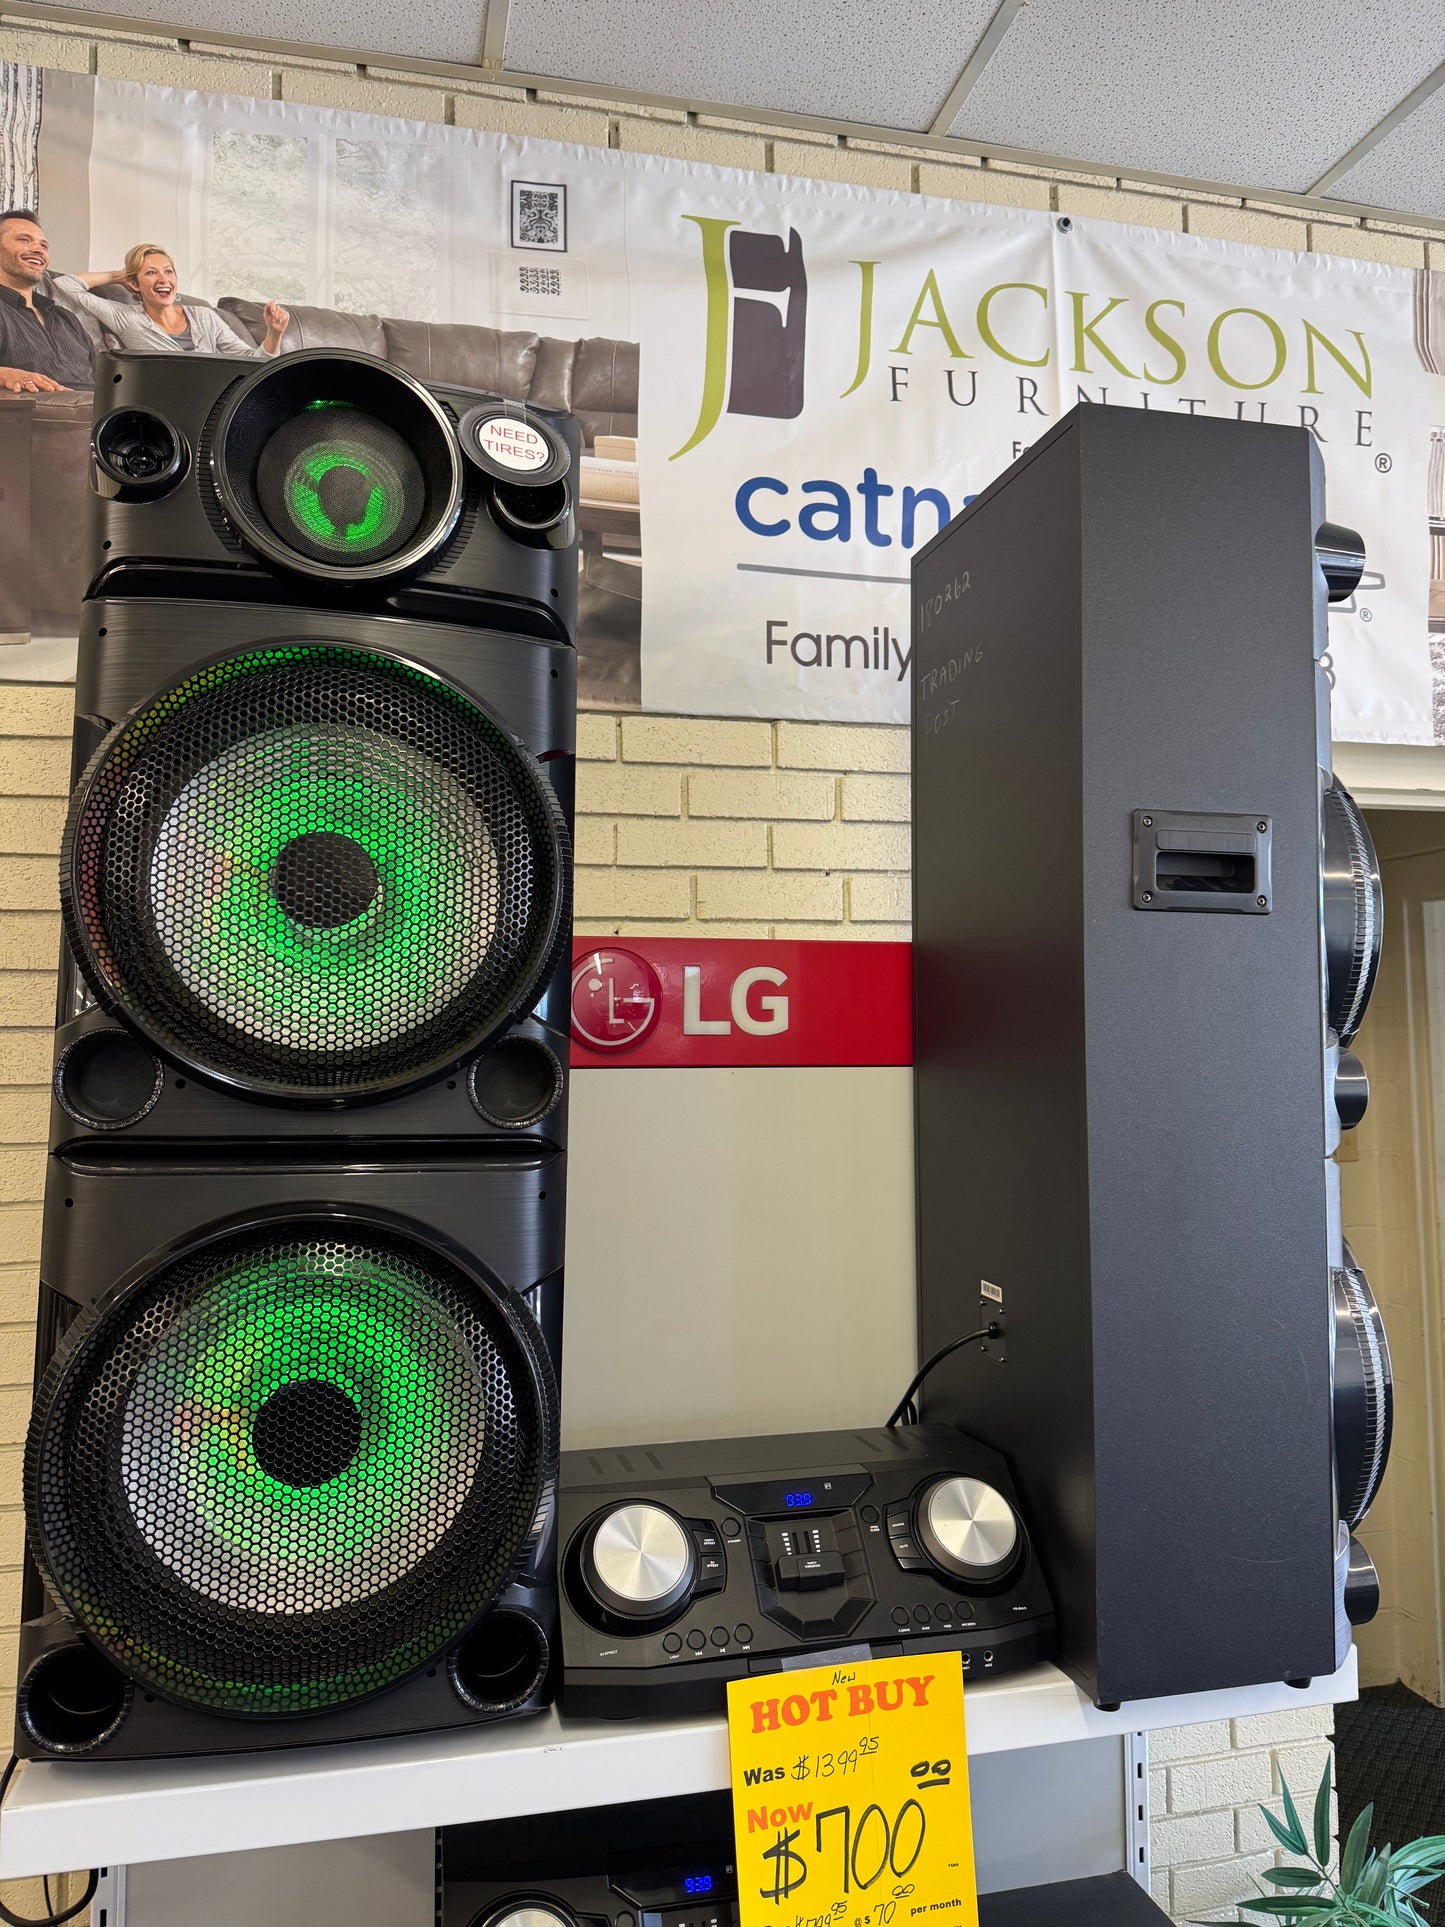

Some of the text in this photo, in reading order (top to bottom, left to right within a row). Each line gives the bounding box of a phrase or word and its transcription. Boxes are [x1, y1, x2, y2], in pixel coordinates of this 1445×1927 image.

[839, 259, 1373, 402] JACKSON
[484, 439, 545, 462] TIRES?
[490, 424, 538, 445] NEED
[735, 467, 980, 549] catn
[766, 620, 911, 682] Family
[920, 642, 984, 700] TRADING
[683, 966, 789, 1036] LG
[750, 1674, 936, 1734] HOT BUY
[831, 1669, 856, 1686] New
[743, 1766, 786, 1787] Was
[747, 1801, 814, 1833] Now
[759, 1798, 926, 1906] $700
[910, 1904, 927, 1917] per
[930, 1898, 962, 1911] month
